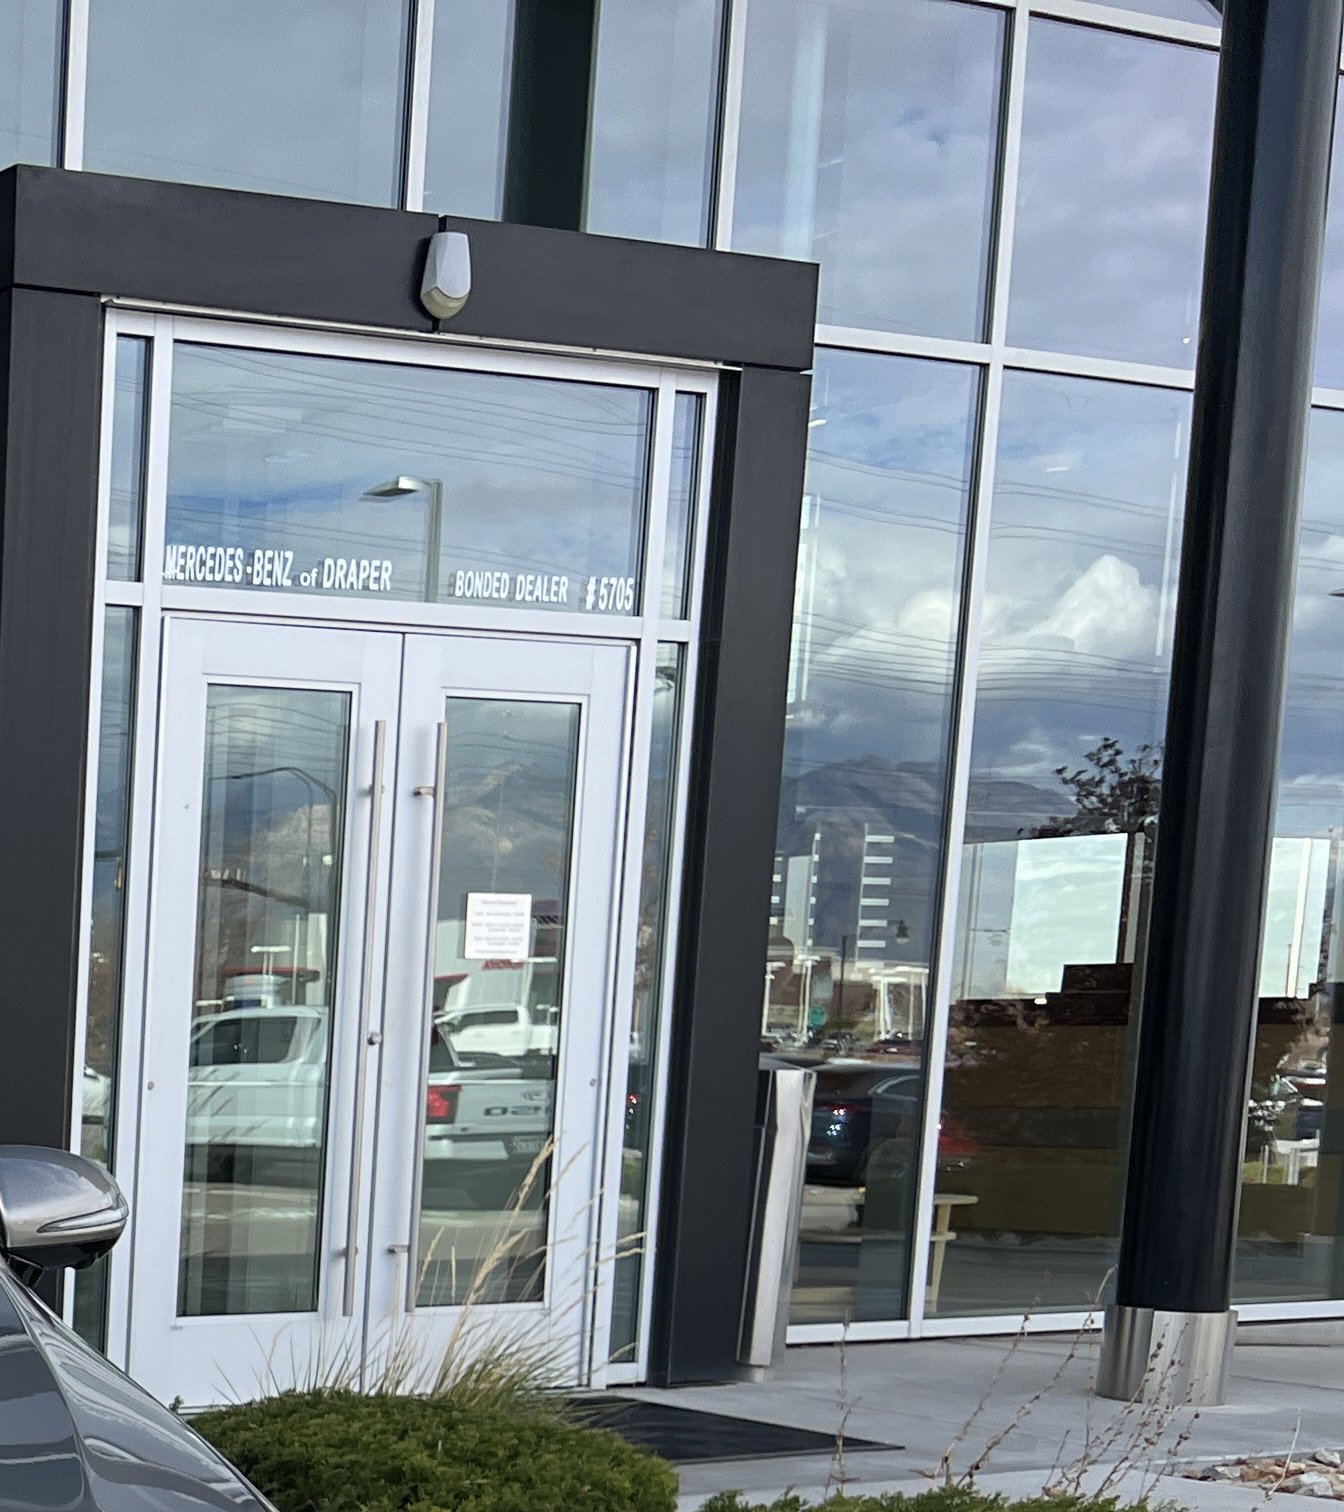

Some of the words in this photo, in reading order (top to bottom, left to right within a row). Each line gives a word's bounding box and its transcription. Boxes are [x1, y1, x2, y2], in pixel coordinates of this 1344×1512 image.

[300, 567, 318, 587] of
[322, 557, 393, 591] DRAPER
[455, 569, 510, 599] BONDED
[515, 574, 569, 602] DEALER
